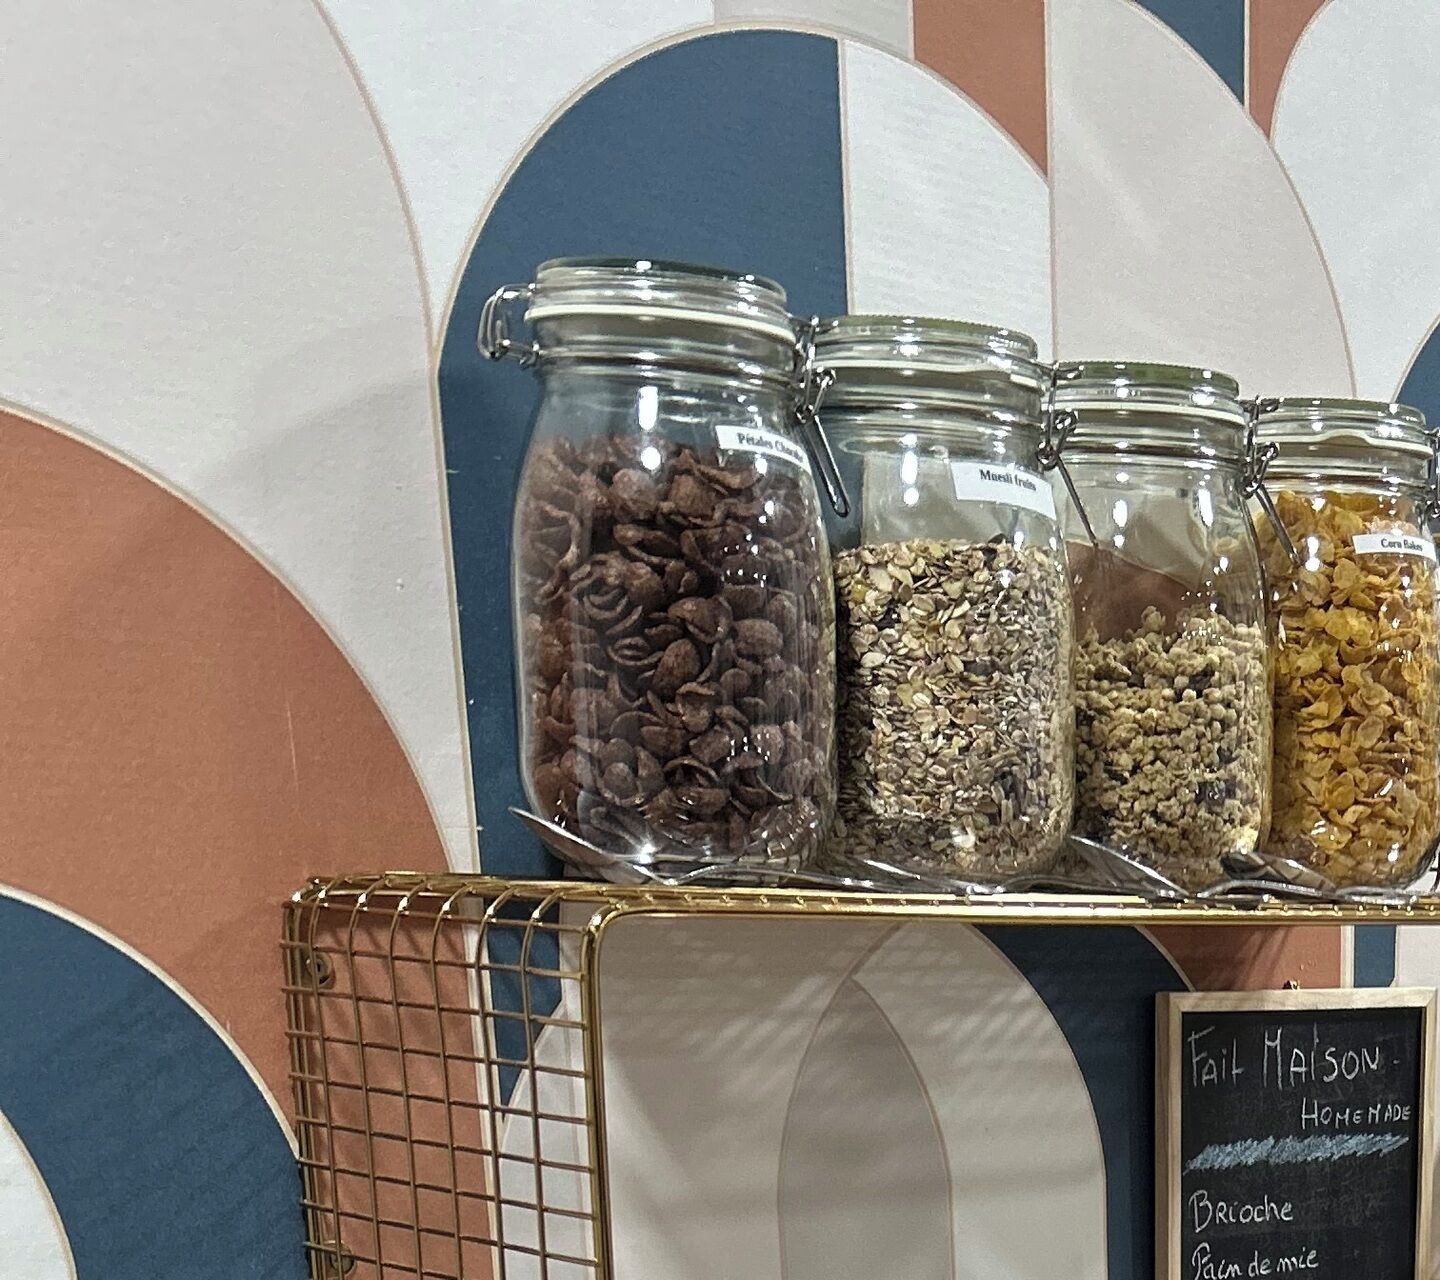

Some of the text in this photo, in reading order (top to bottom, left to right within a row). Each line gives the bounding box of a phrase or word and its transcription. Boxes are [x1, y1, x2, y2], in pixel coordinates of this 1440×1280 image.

[979, 468, 1013, 485] Muesli
[1380, 538, 1402, 549] Corn
[1247, 1249, 1272, 1278] de
[1276, 1246, 1320, 1272] mie
